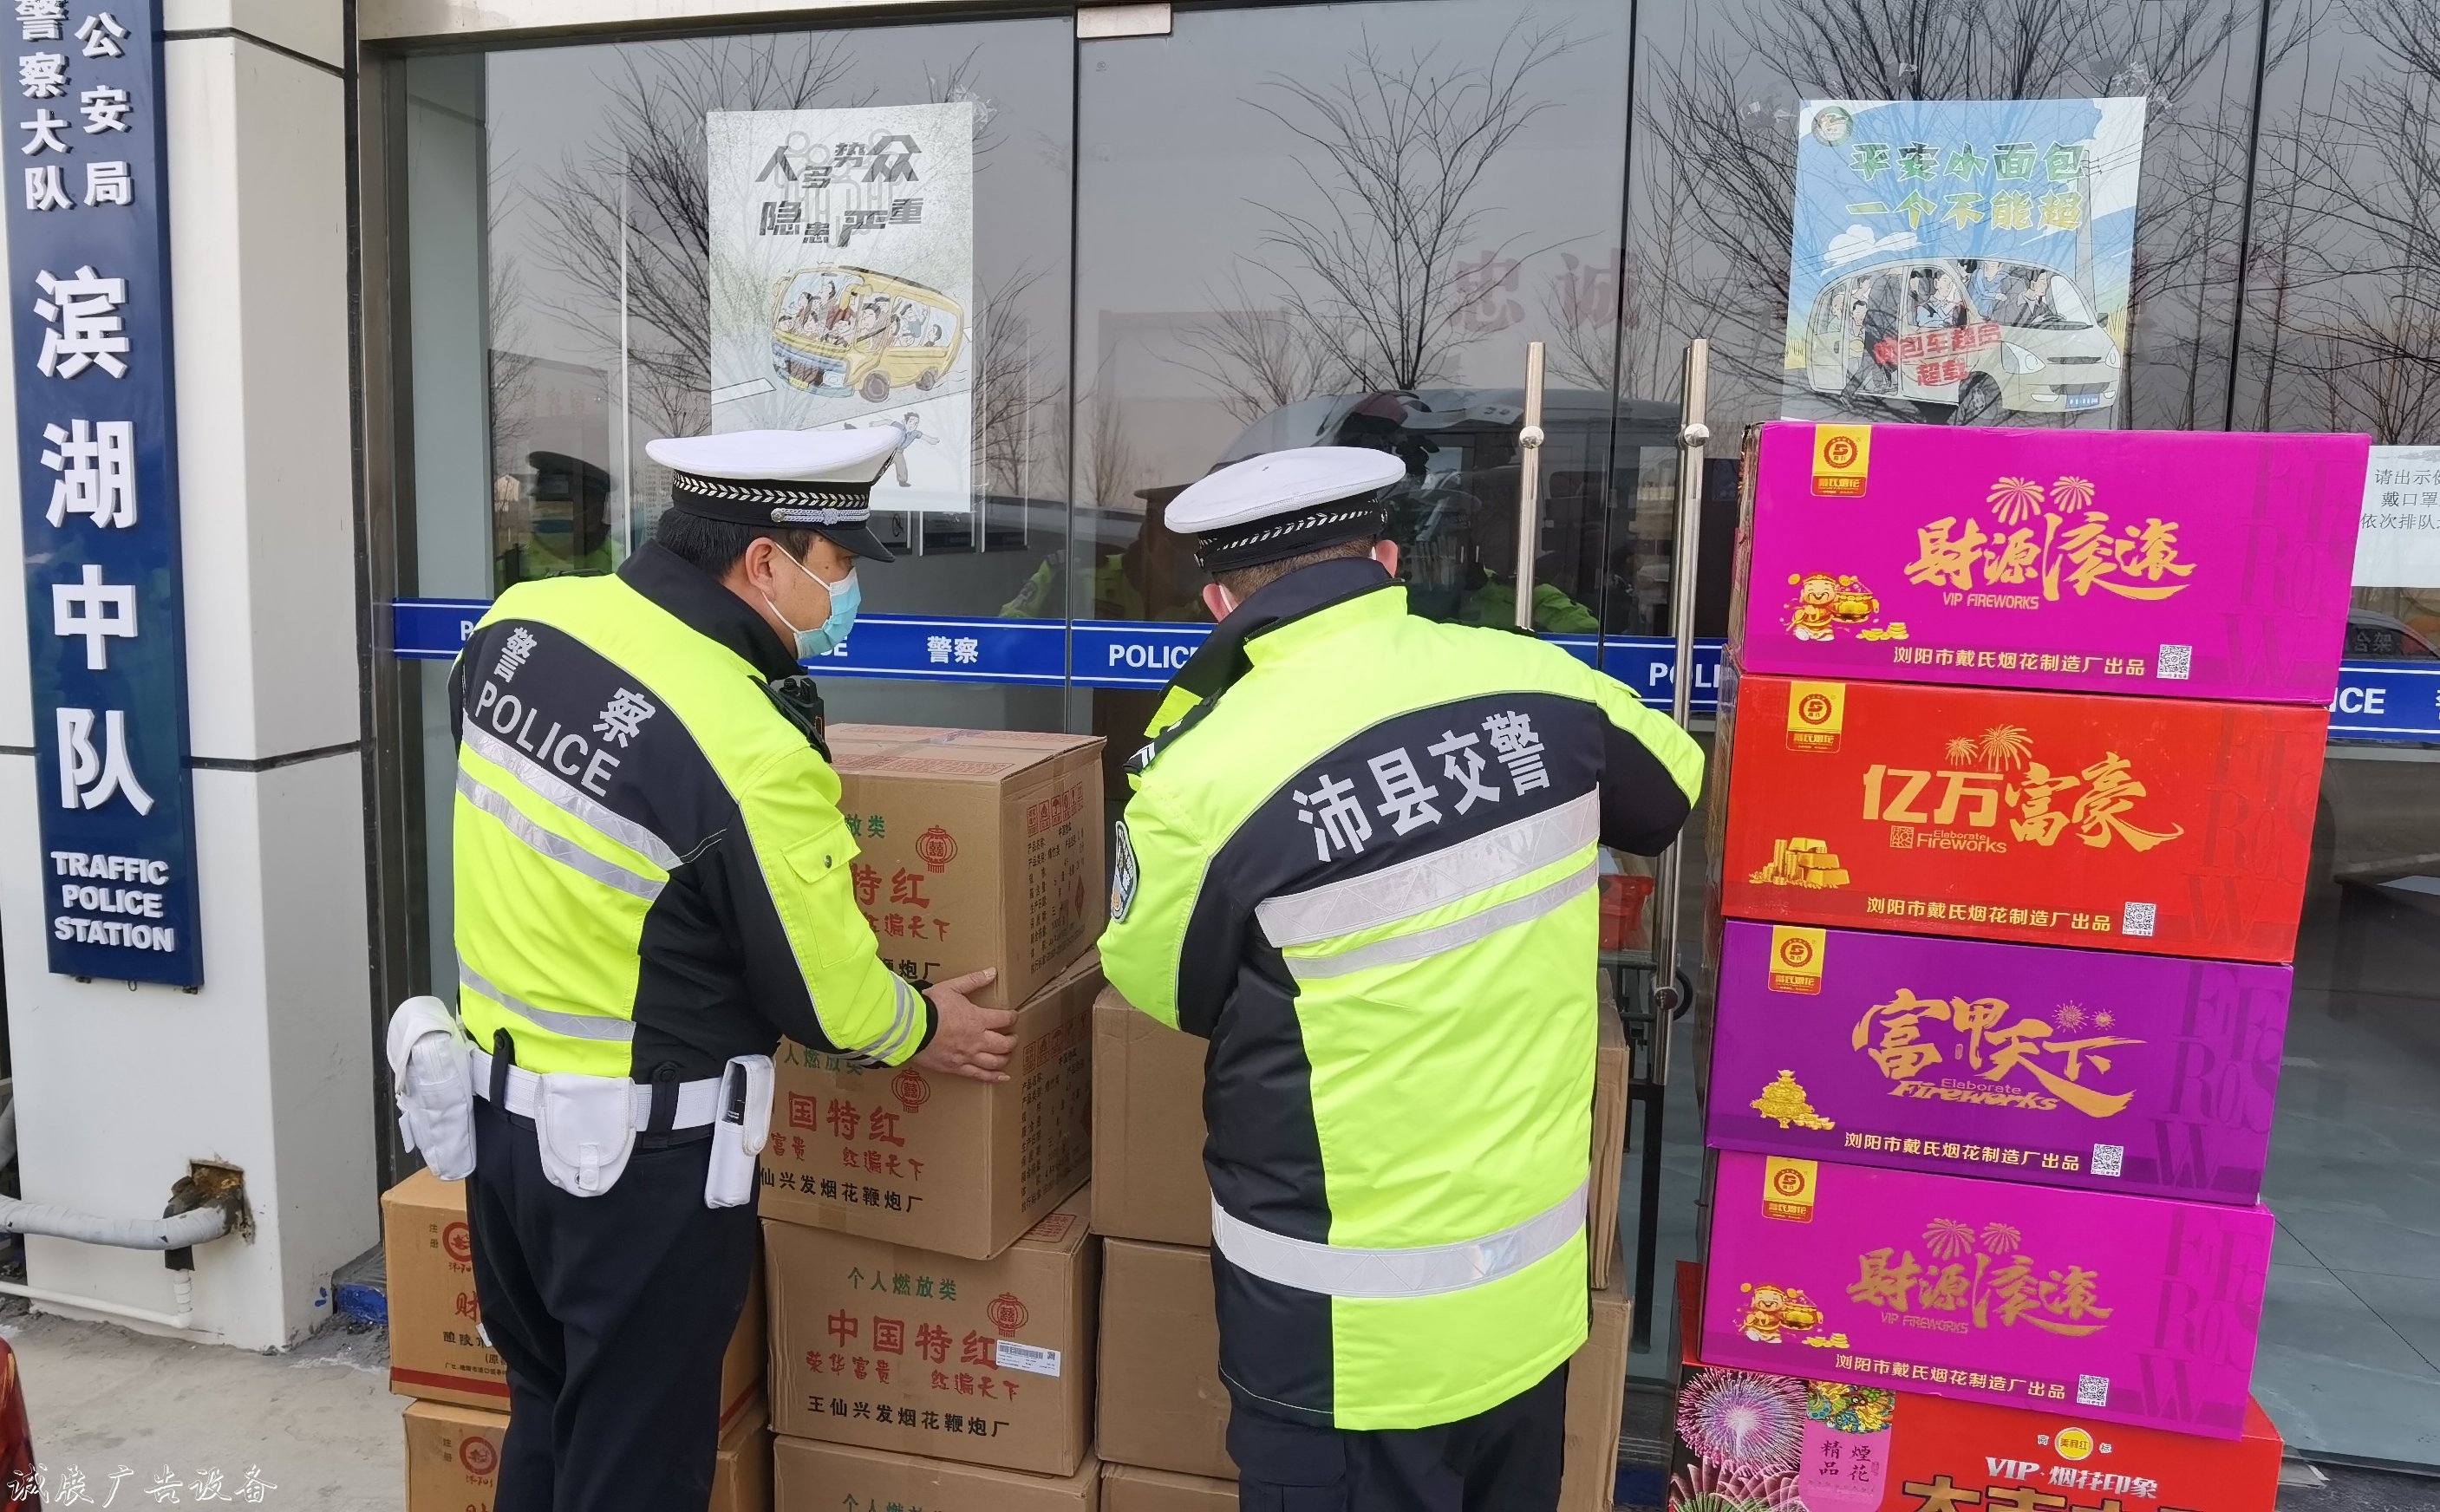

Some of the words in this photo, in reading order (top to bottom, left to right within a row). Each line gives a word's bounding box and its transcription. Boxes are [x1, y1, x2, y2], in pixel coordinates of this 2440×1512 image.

[15, 0, 76, 211] 警察大队
[75, 11, 133, 207] 公安局
[755, 134, 923, 189] 人多势众
[1849, 140, 2090, 182] 平安小面包
[760, 198, 923, 247] 隐患严重
[1845, 190, 2083, 231] 一个不能超
[2381, 492, 2440, 508] 戴口罩
[33, 265, 155, 816] 滨湖中队
[2360, 513, 2440, 530] 依次排队
[1943, 591, 1963, 607] VIP
[1967, 593, 2039, 610] FIREWORKS
[927, 635, 978, 664] 警察
[1893, 646, 2145, 676] 浏阳市戴氏烟花制造厂出品
[475, 680, 621, 798] POLICE
[1292, 711, 1550, 862] 沛县交警
[1863, 752, 2184, 852] 亿万富豪
[1917, 833, 2006, 853] Fireworks
[1934, 830, 1986, 840] Elaborate
[50, 851, 169, 886] TRAFFIC
[62, 884, 163, 919] POLICE
[1866, 896, 2111, 932] 浏阳市戴氏烟花制造厂出品
[55, 917, 174, 952] STATION
[1852, 987, 2148, 1118] 富甲天下
[1887, 1081, 2060, 1111] Fireworks
[1941, 1079, 2021, 1094] Elaborate
[1843, 1131, 2080, 1172] 浏阳市戴氏烟花制造厂出品
[848, 1267, 957, 1300] 个人燃放类
[828, 1309, 999, 1370] 中国特红
[806, 1350, 891, 1385] 荣华富贵
[1835, 1354, 2065, 1400] 浏阳市戴氏烟花制造厂出品
[808, 1395, 1010, 1437] 王仙兴发烟花鞭炮厂
